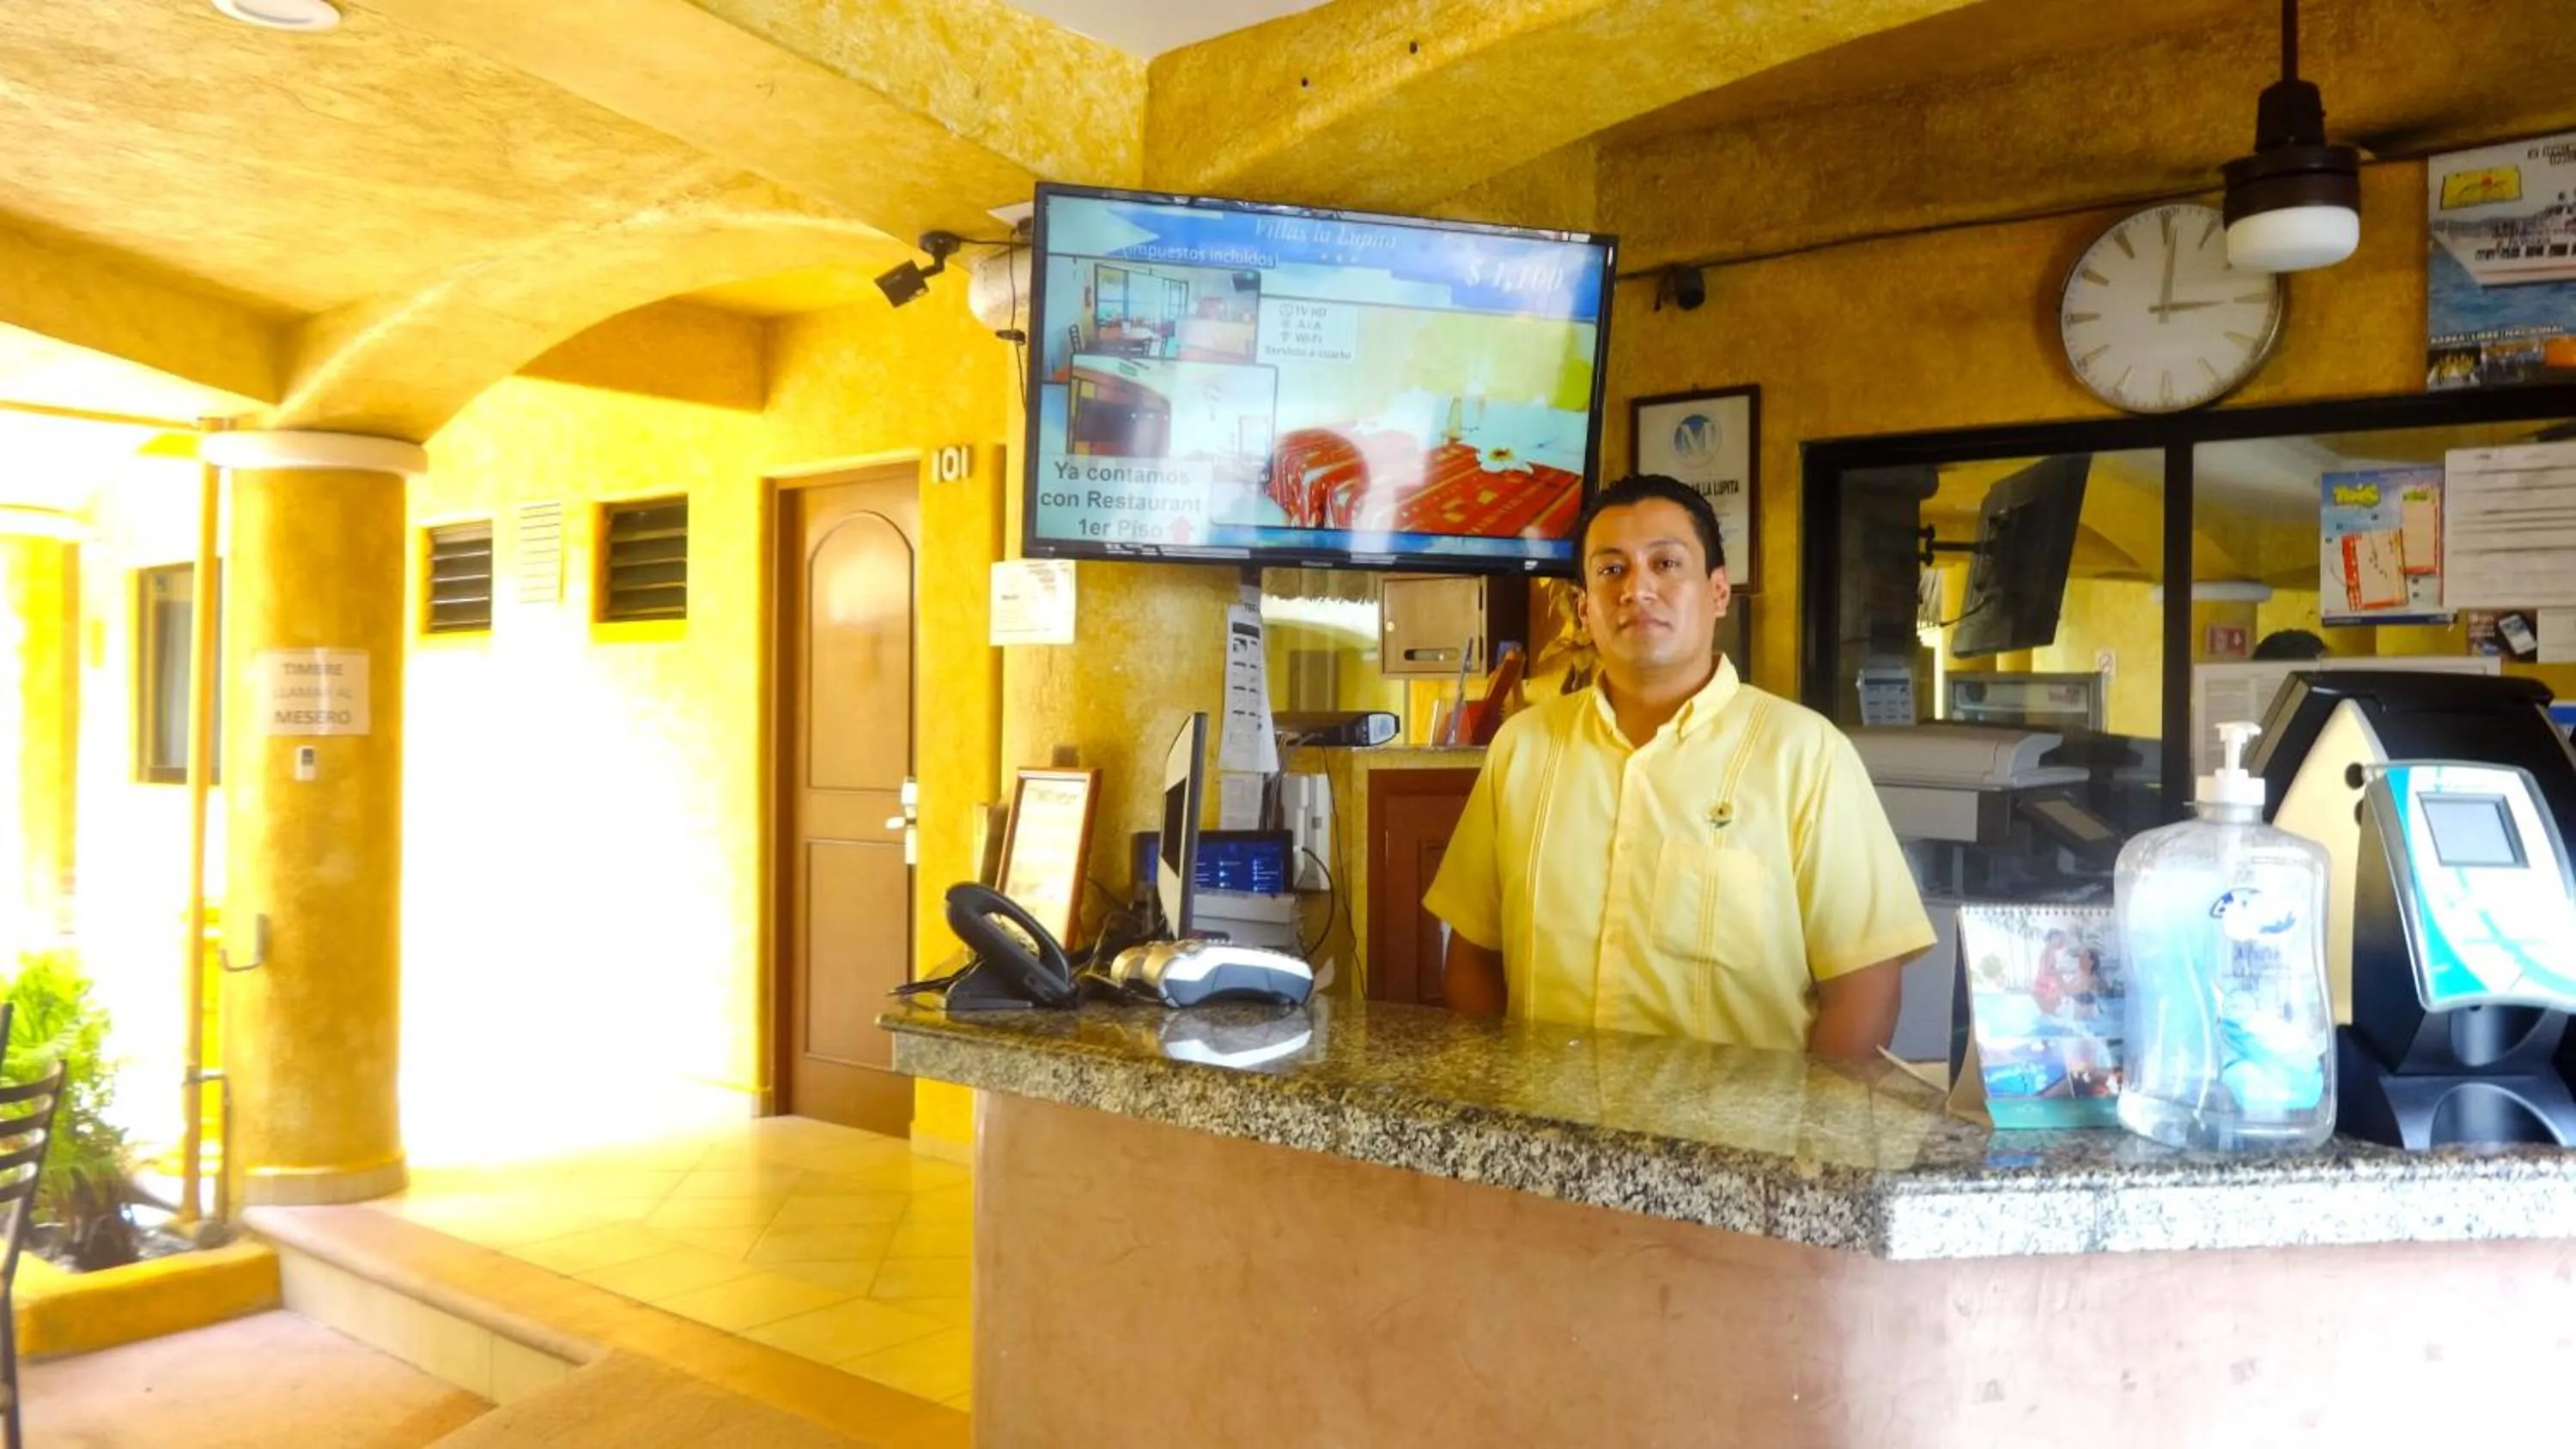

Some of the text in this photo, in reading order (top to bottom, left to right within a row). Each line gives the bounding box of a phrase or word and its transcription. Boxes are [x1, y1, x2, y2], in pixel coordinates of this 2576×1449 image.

[1255, 218, 1309, 242] Villas
[1314, 224, 1331, 244] la
[932, 445, 969, 484] 101
[1054, 461, 1192, 484] Ya contamos
[1040, 490, 1202, 513] con Restaurant
[1079, 518, 1163, 538] 1er Piso
[283, 662, 344, 676] TIMBRE
[274, 709, 352, 725] MESERO
